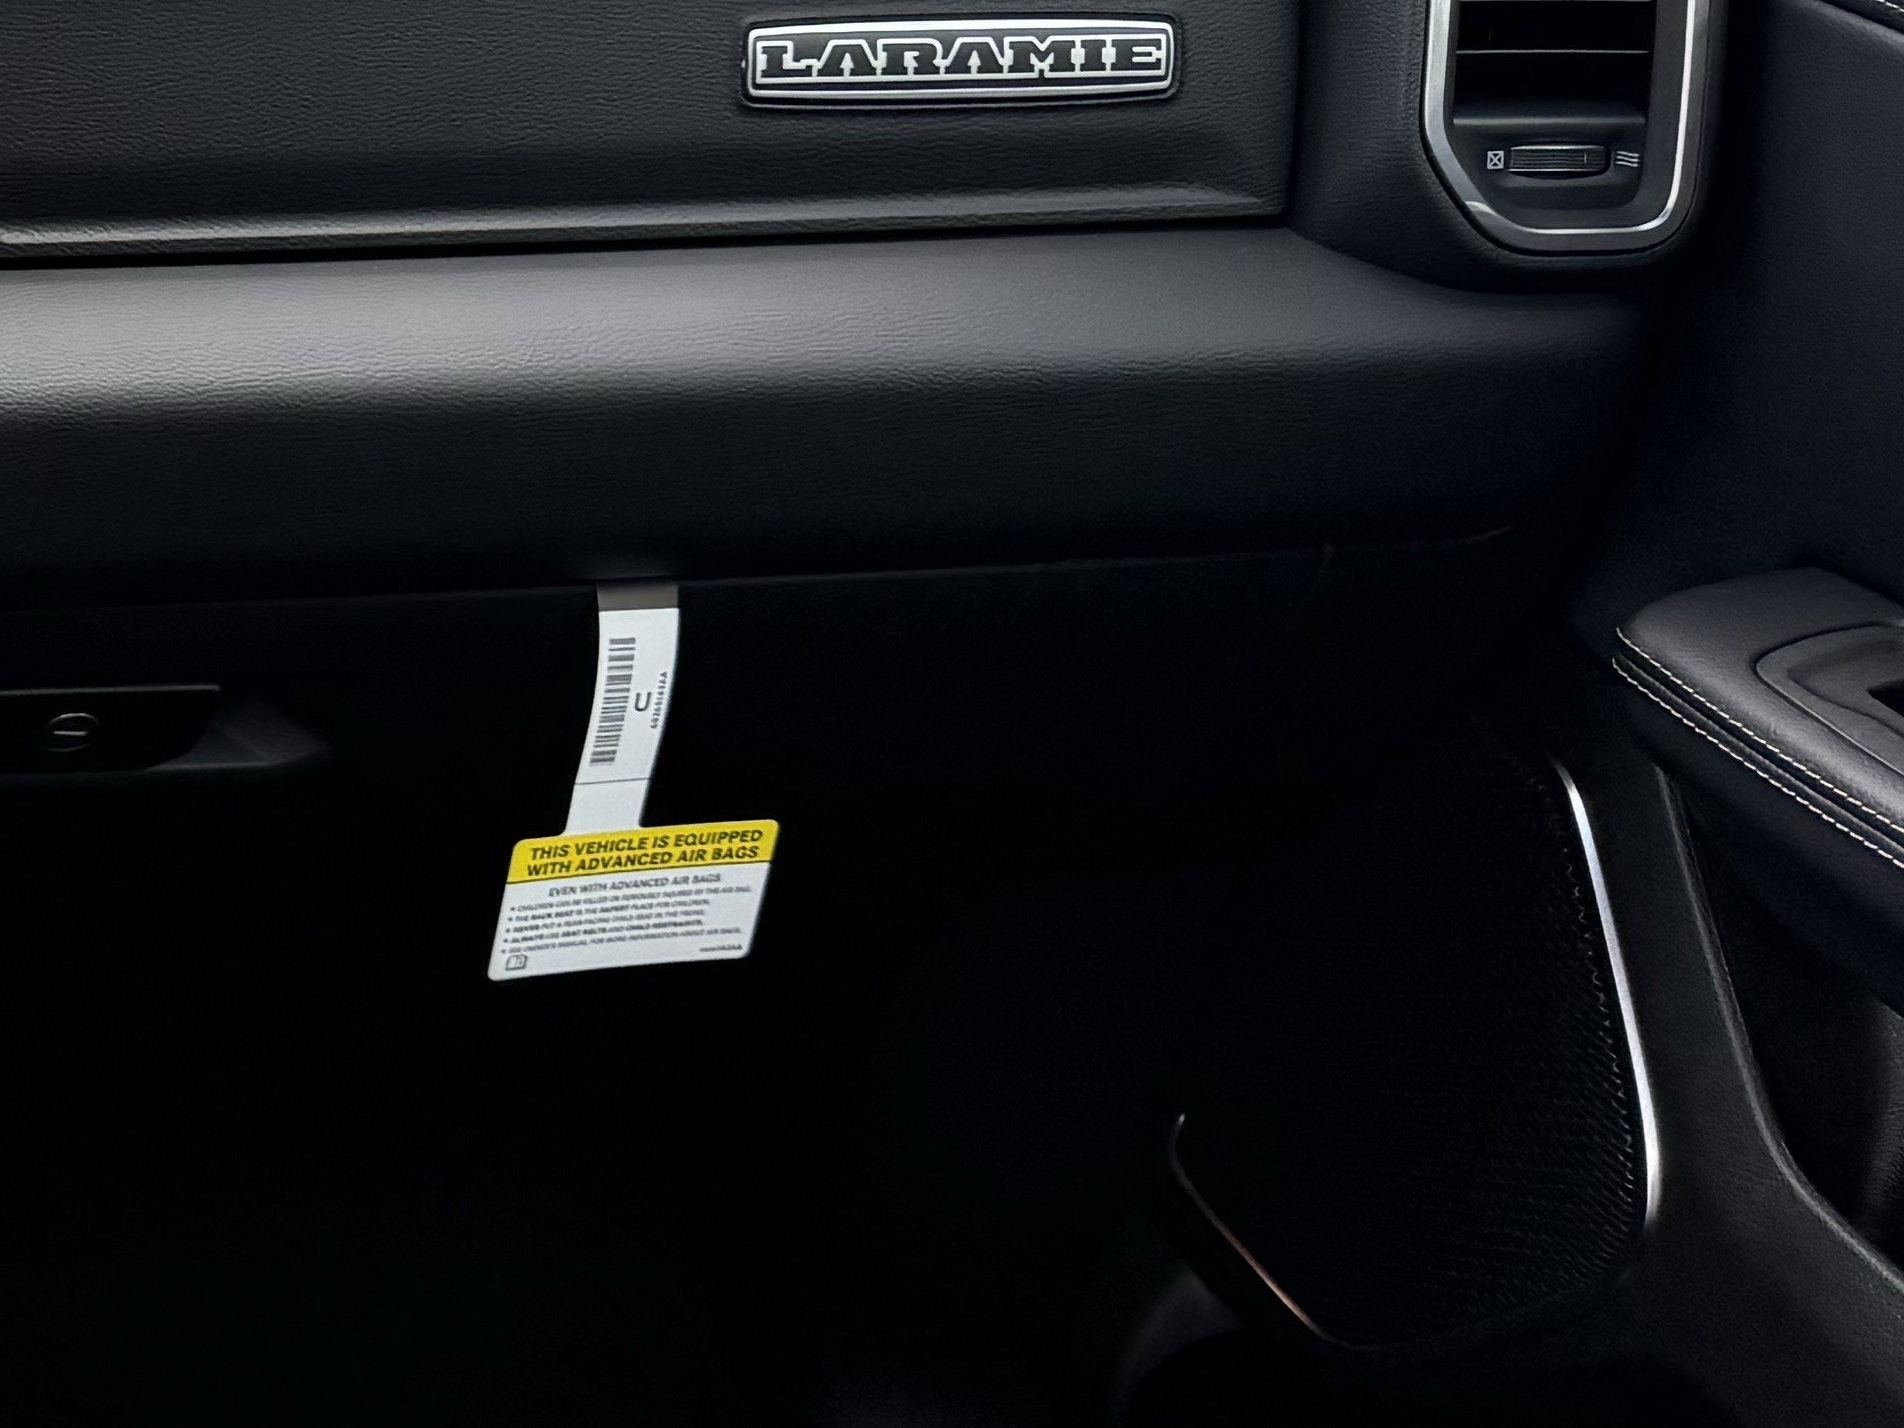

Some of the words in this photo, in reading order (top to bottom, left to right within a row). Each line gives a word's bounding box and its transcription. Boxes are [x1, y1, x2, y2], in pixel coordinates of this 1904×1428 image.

[755, 36, 1166, 81] LARAMIE
[634, 691, 653, 712] U
[530, 844, 570, 861] THIS
[574, 836, 648, 856] VEHICLE
[652, 835, 669, 849] IS
[673, 828, 764, 848] EQUIPPED
[526, 859, 573, 877] WITH
[575, 852, 672, 874] ADVANCED
[676, 849, 708, 863] AIR
[712, 845, 760, 861] BAGS
[548, 886, 578, 897] EVEN
[578, 883, 608, 893] WITH
[609, 877, 670, 890] ADVANCED
[671, 874, 691, 885] AIR
[692, 873, 722, 884] BAGS
